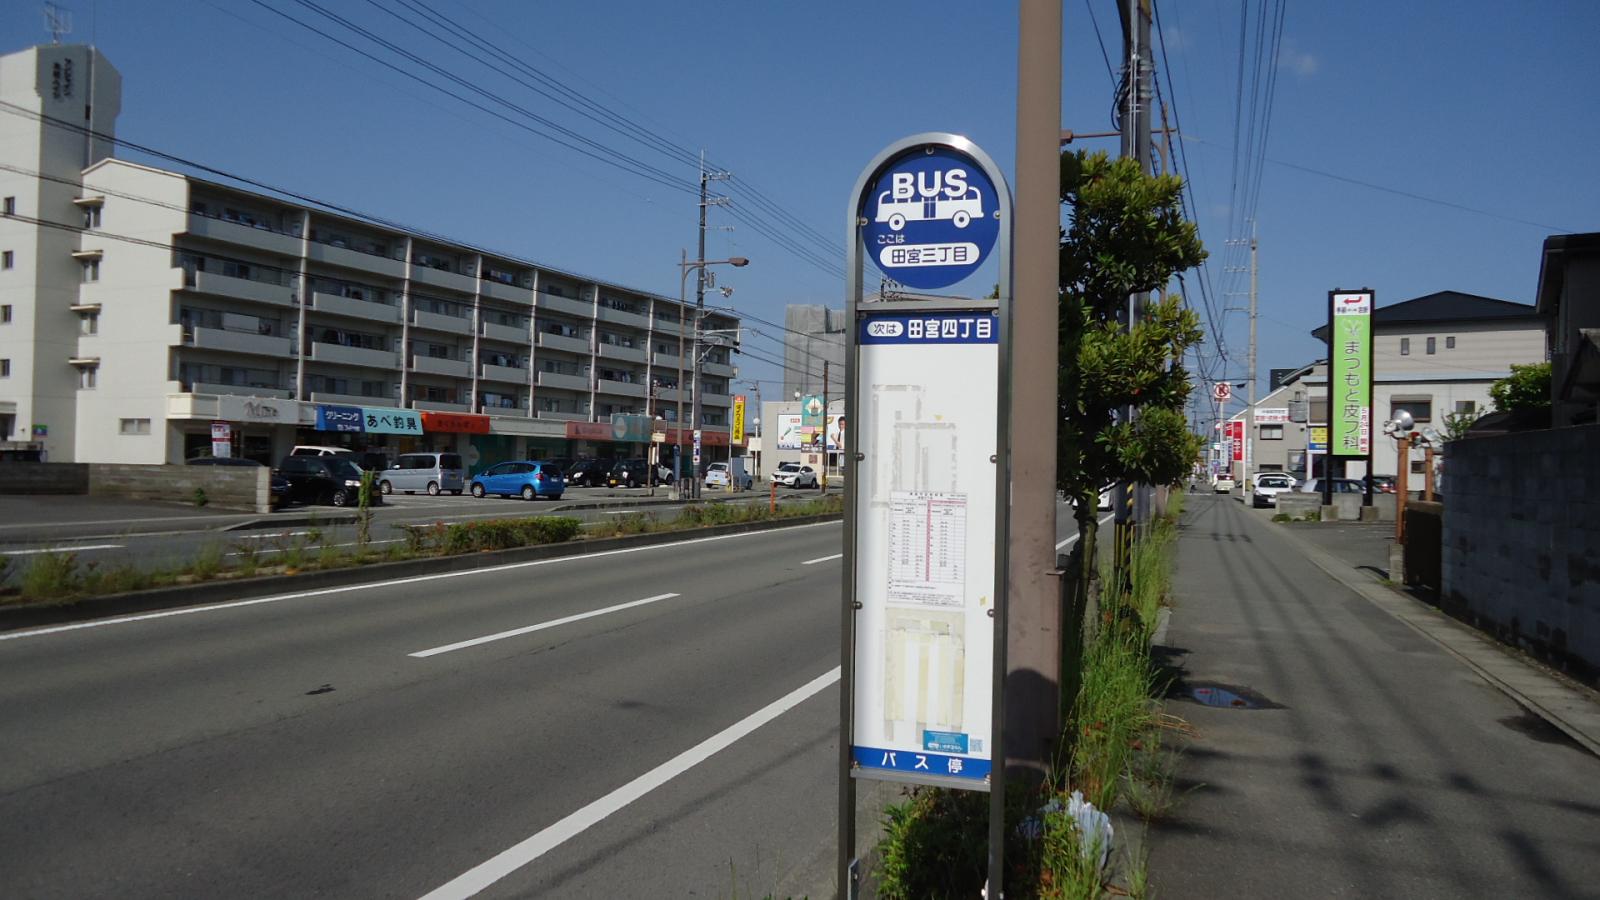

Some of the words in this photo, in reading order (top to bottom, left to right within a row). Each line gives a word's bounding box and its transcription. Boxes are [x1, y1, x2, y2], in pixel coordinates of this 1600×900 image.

[892, 169, 968, 199] BUS
[877, 234, 905, 245] ここは
[891, 246, 968, 265] 田宮三丁目
[873, 323, 898, 335] 次は
[908, 318, 991, 339] 田宮四丁目
[1343, 340, 1361, 450] まつもと皮フ科
[325, 409, 360, 422] クリーニング
[366, 414, 417, 431] あべ釣具
[881, 751, 963, 774] バス停
